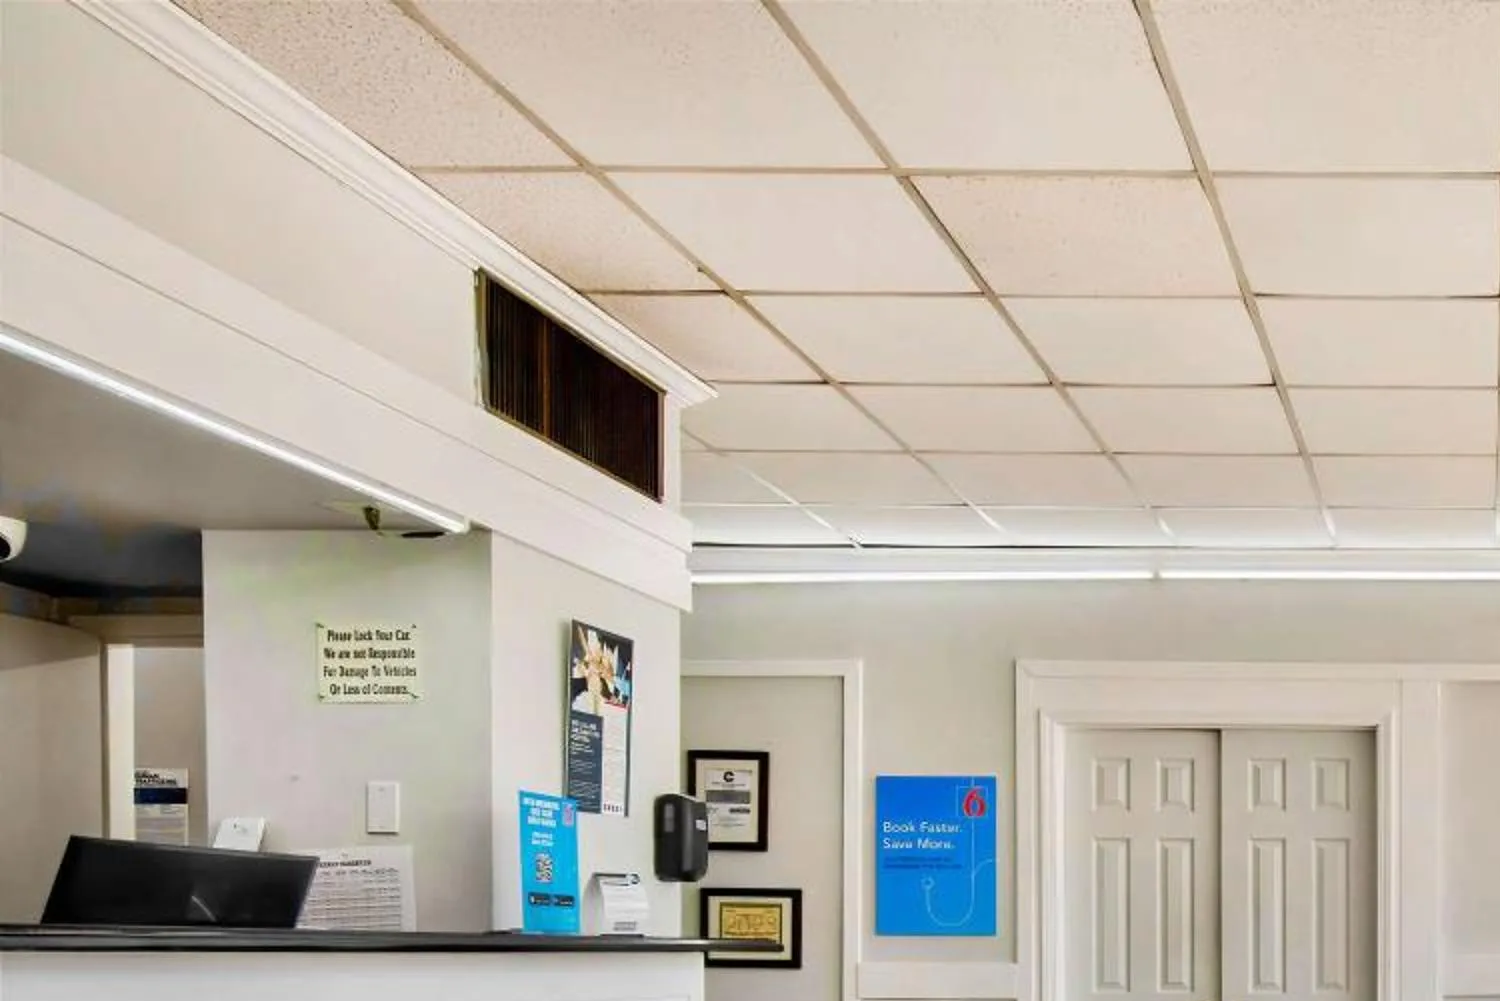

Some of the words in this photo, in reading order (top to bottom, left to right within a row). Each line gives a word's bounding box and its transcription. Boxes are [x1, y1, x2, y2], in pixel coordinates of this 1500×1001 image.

[327, 629, 353, 642] Please
[354, 629, 373, 641] Lock
[375, 629, 393, 641] Your
[323, 647, 336, 659] We
[338, 650, 351, 659] are
[353, 649, 367, 659] not
[368, 647, 416, 661] Responsible
[323, 665, 337, 677] For
[339, 665, 369, 680] Damage
[371, 665, 381, 677] To
[383, 665, 417, 677] Vehicles
[329, 683, 342, 695] Or
[962, 785, 987, 819] 6
[883, 820, 915, 833] Book
[920, 820, 964, 833] Faster.
[883, 837, 913, 849] Save
[917, 837, 956, 849] More.
